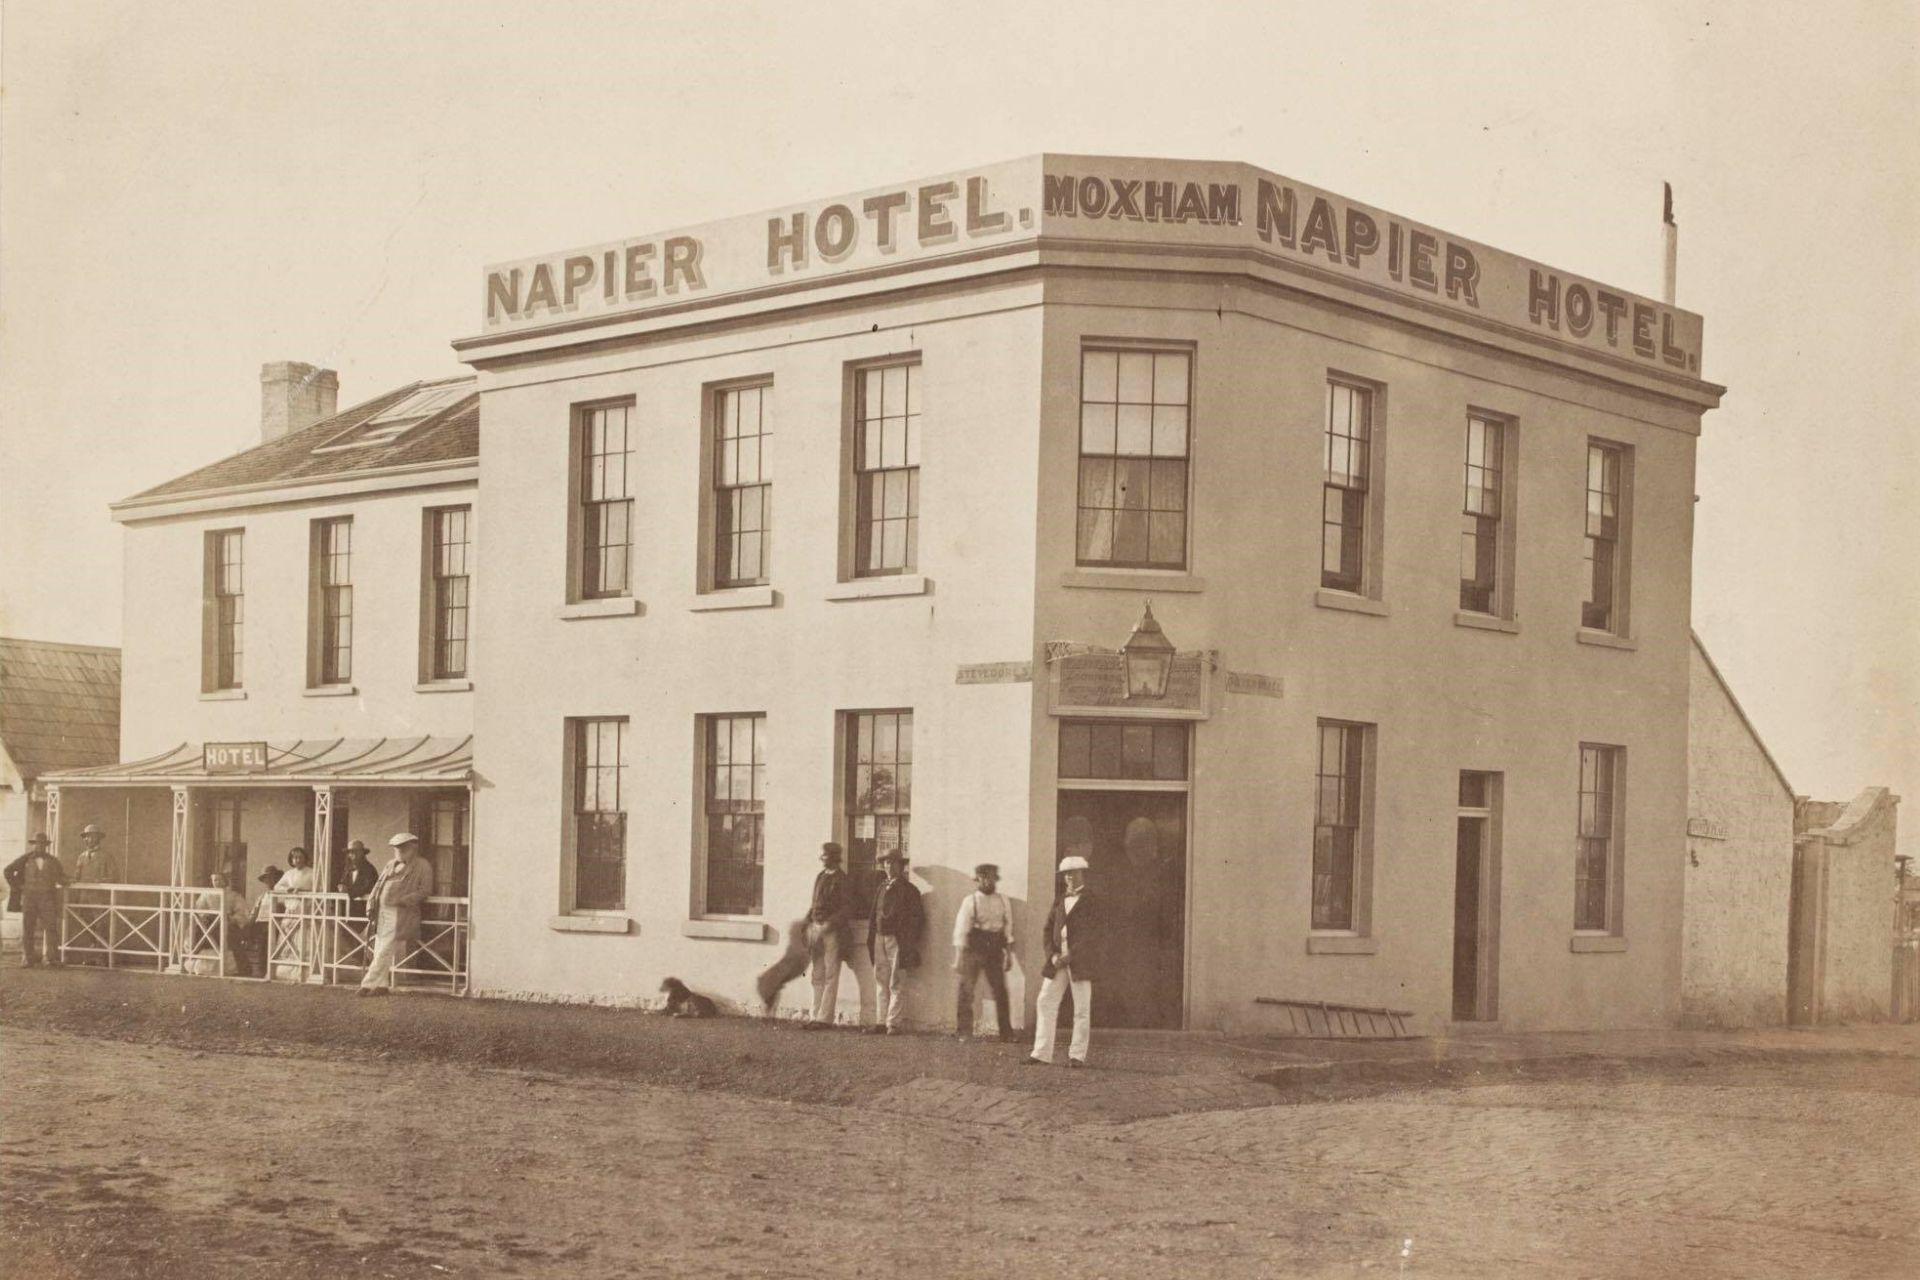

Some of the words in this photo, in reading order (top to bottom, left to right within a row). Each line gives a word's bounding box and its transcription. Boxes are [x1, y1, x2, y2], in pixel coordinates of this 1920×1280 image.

[487, 235, 707, 327] NAPIER
[766, 175, 1033, 276] HOTEL.
[1043, 173, 1244, 227] MOXHAM
[1256, 177, 1481, 309] NAPIER
[1528, 268, 1697, 373] HOTEL.
[206, 748, 264, 766] HOTEL
